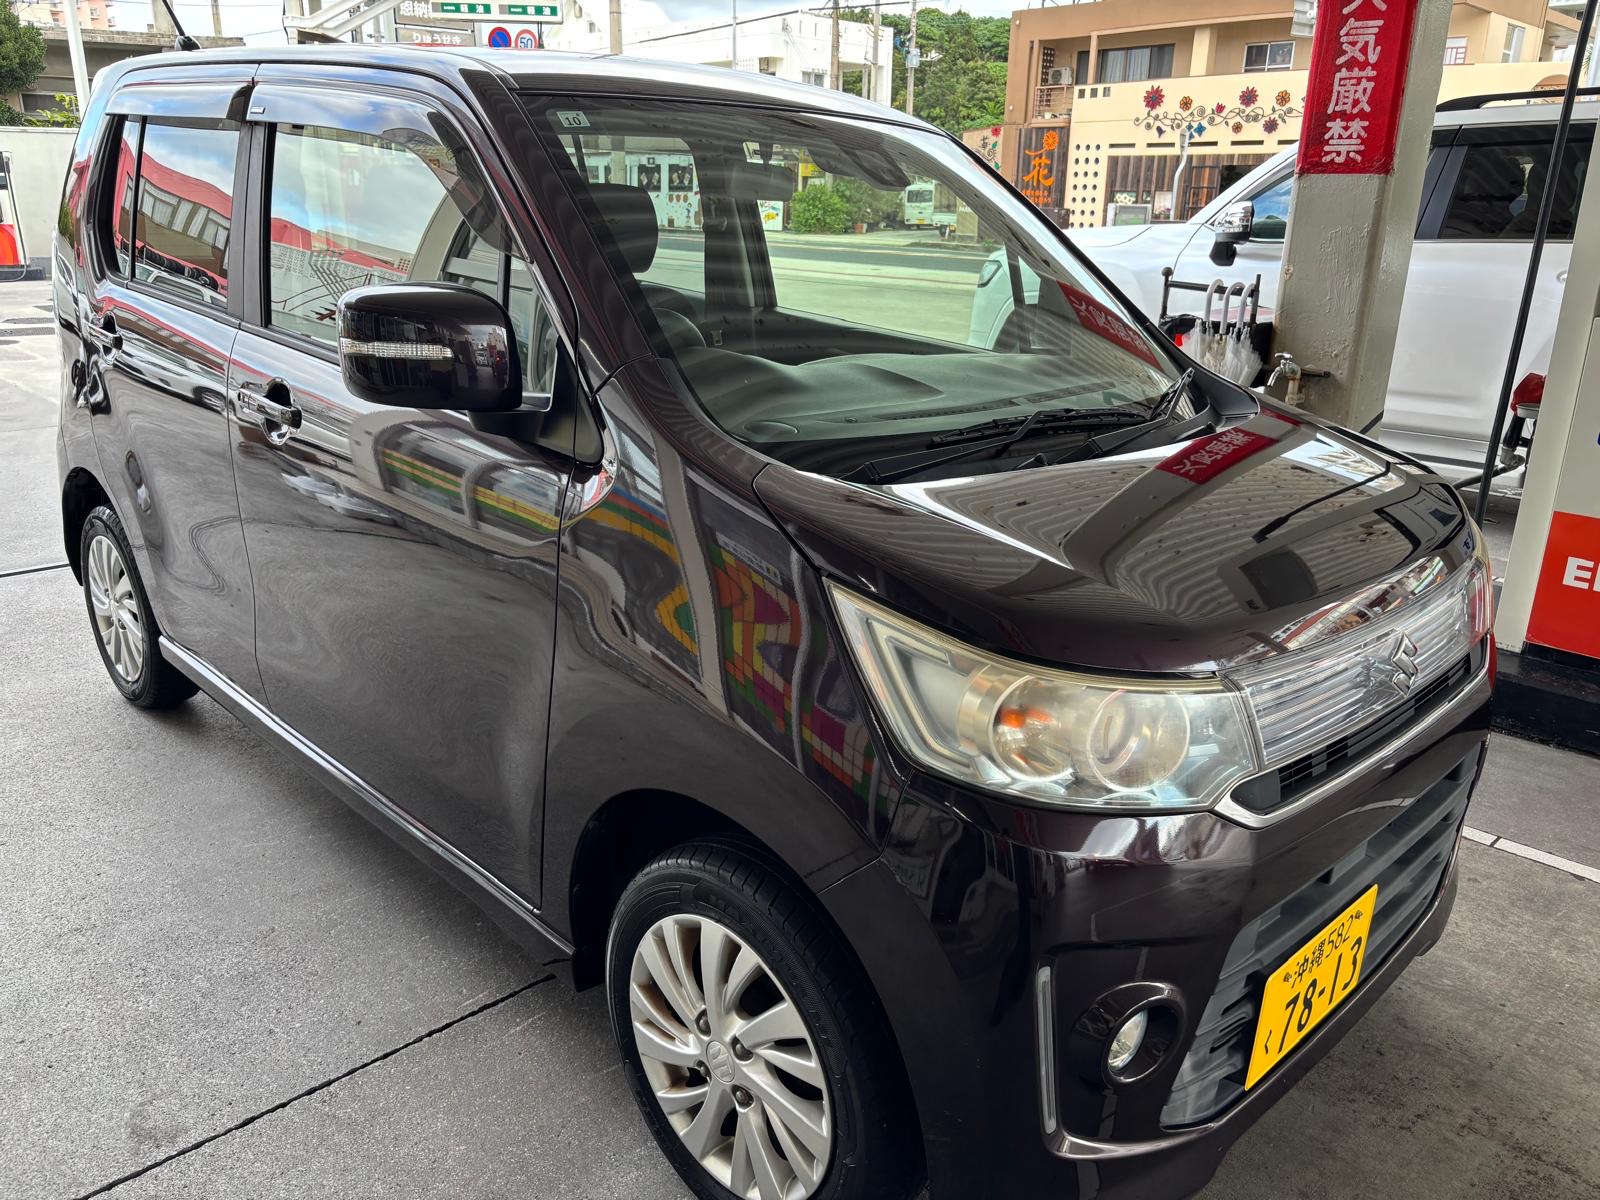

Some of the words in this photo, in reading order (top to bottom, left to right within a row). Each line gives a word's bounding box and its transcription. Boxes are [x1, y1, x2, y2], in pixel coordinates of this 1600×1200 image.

[520, 37, 533, 48] 50
[565, 116, 581, 126] 10
[1291, 938, 1326, 989] 沖縄
[1325, 913, 1354, 959] 582
[1277, 935, 1363, 1055] 78-13
